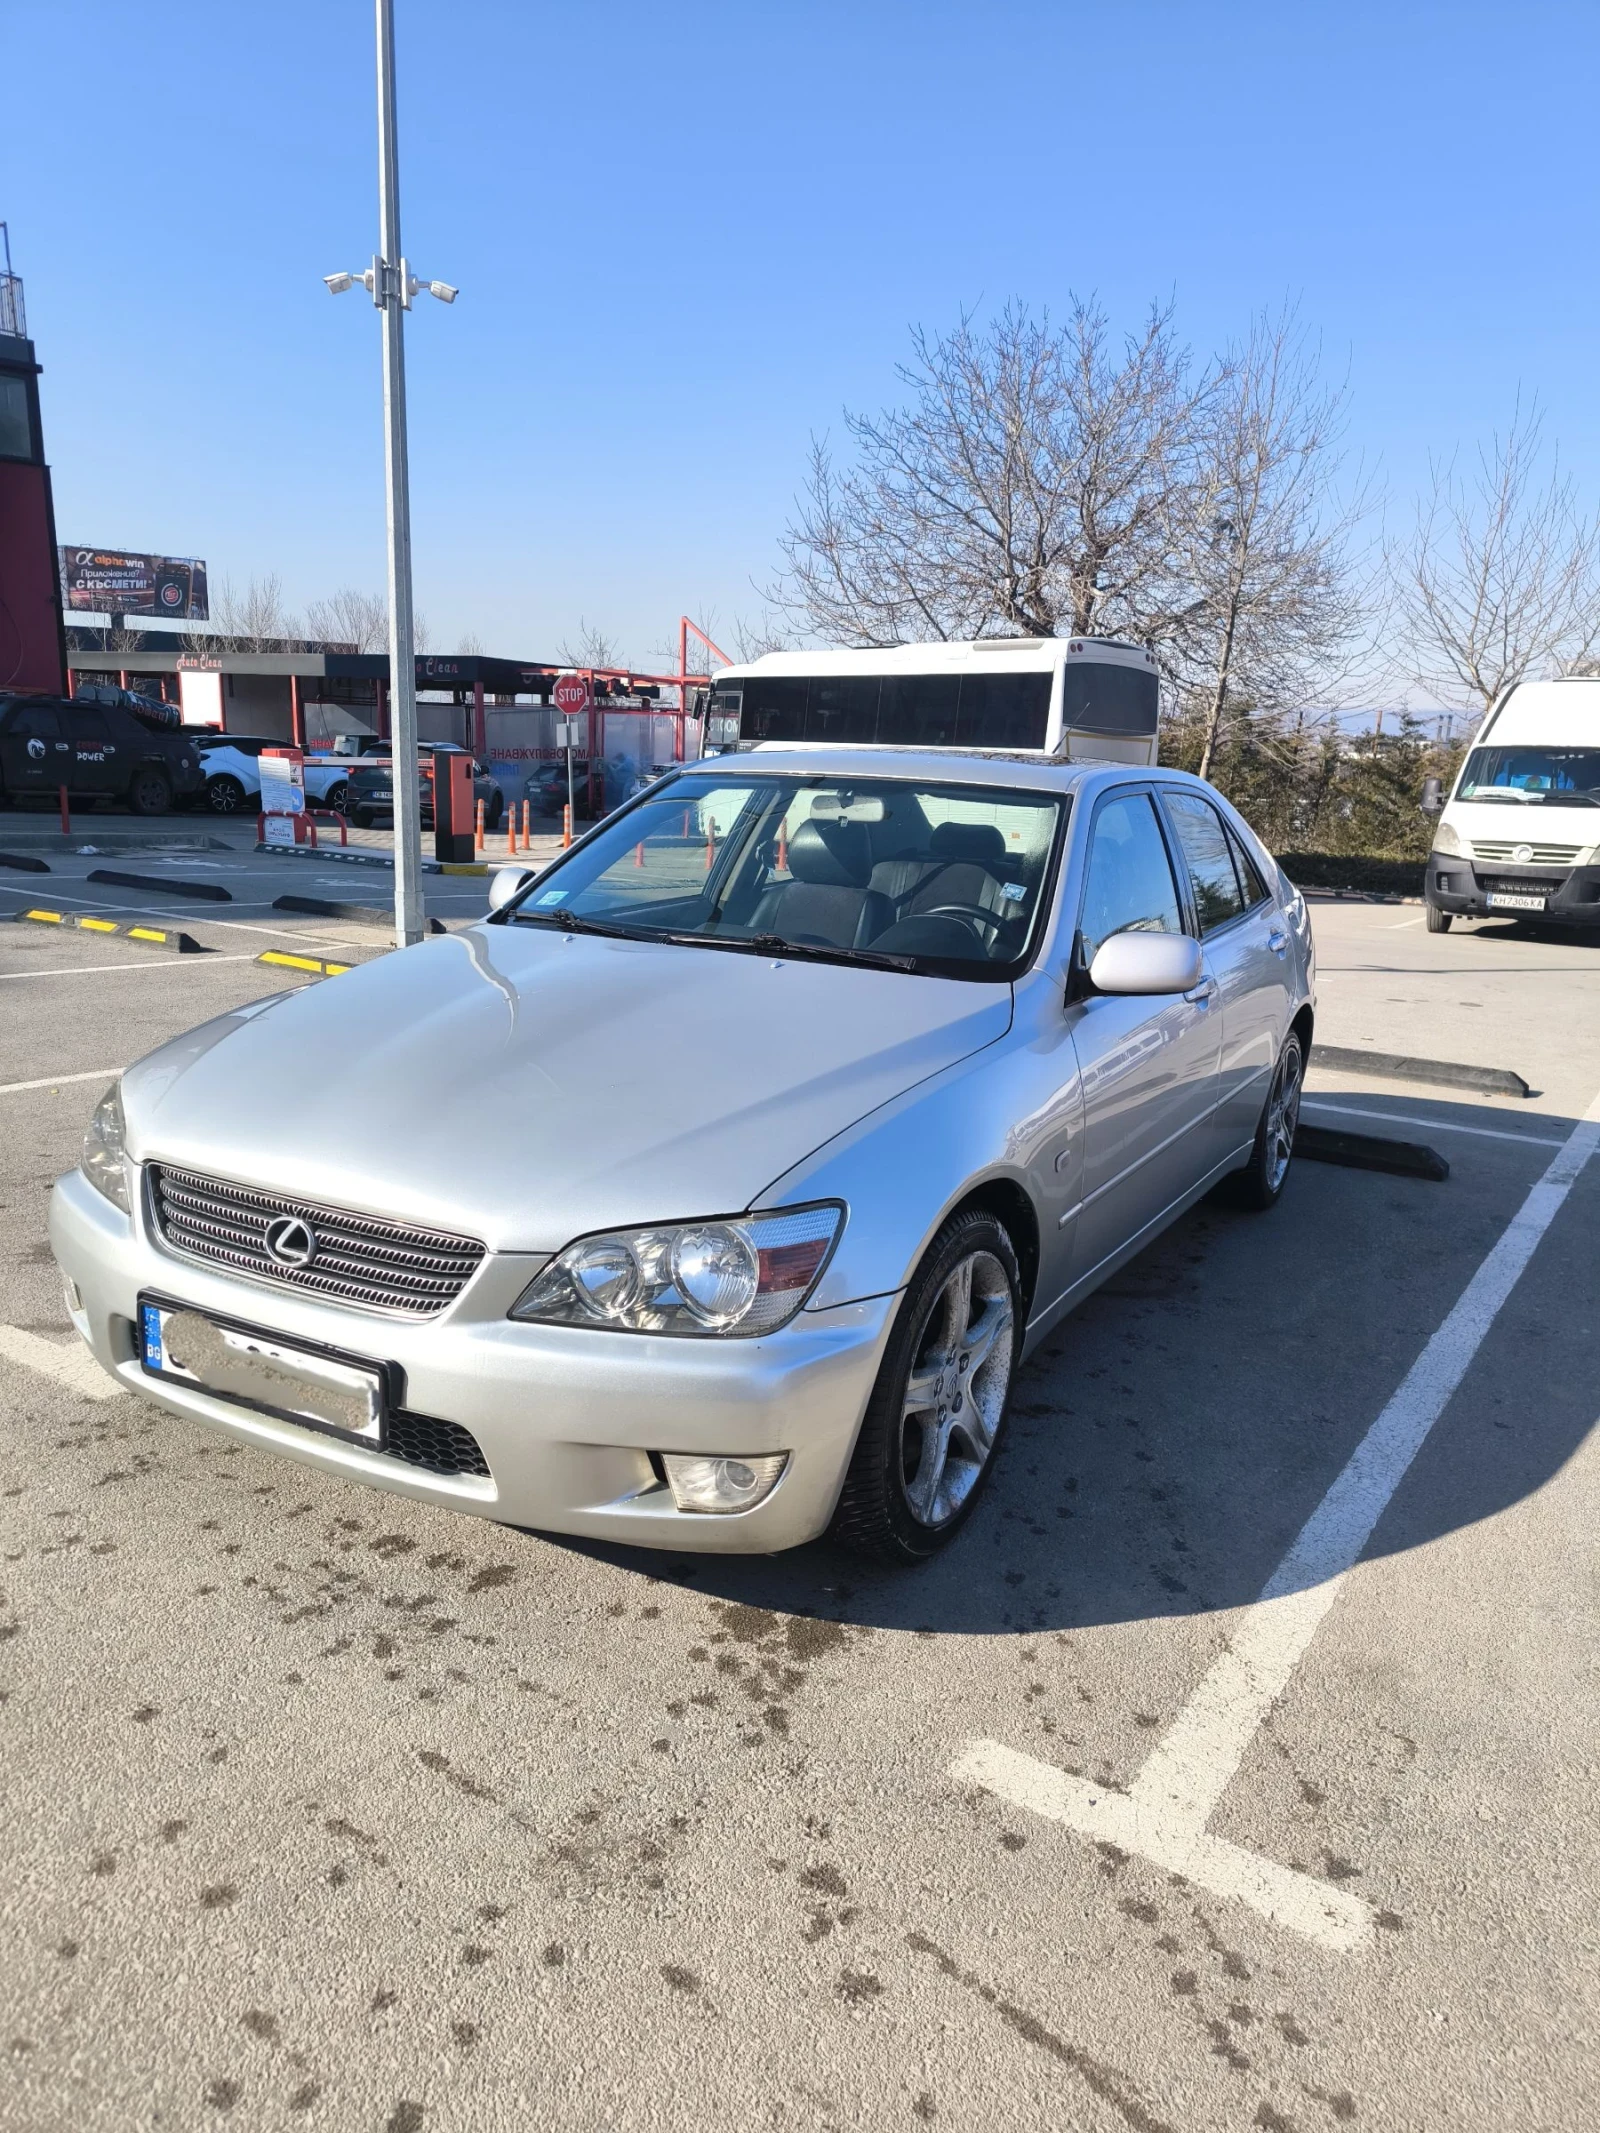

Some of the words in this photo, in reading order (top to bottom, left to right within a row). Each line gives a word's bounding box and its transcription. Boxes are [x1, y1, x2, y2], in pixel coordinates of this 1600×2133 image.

[95, 555, 145, 568] alphawin
[87, 580, 147, 589] КЪСМЕТИ!
[177, 654, 198, 670] Auto
[200, 654, 222, 669] Clean
[425, 657, 459, 675] Clean
[558, 687, 583, 703] STOP
[76, 752, 105, 762] POWER
[147, 1343, 161, 1360] BG
